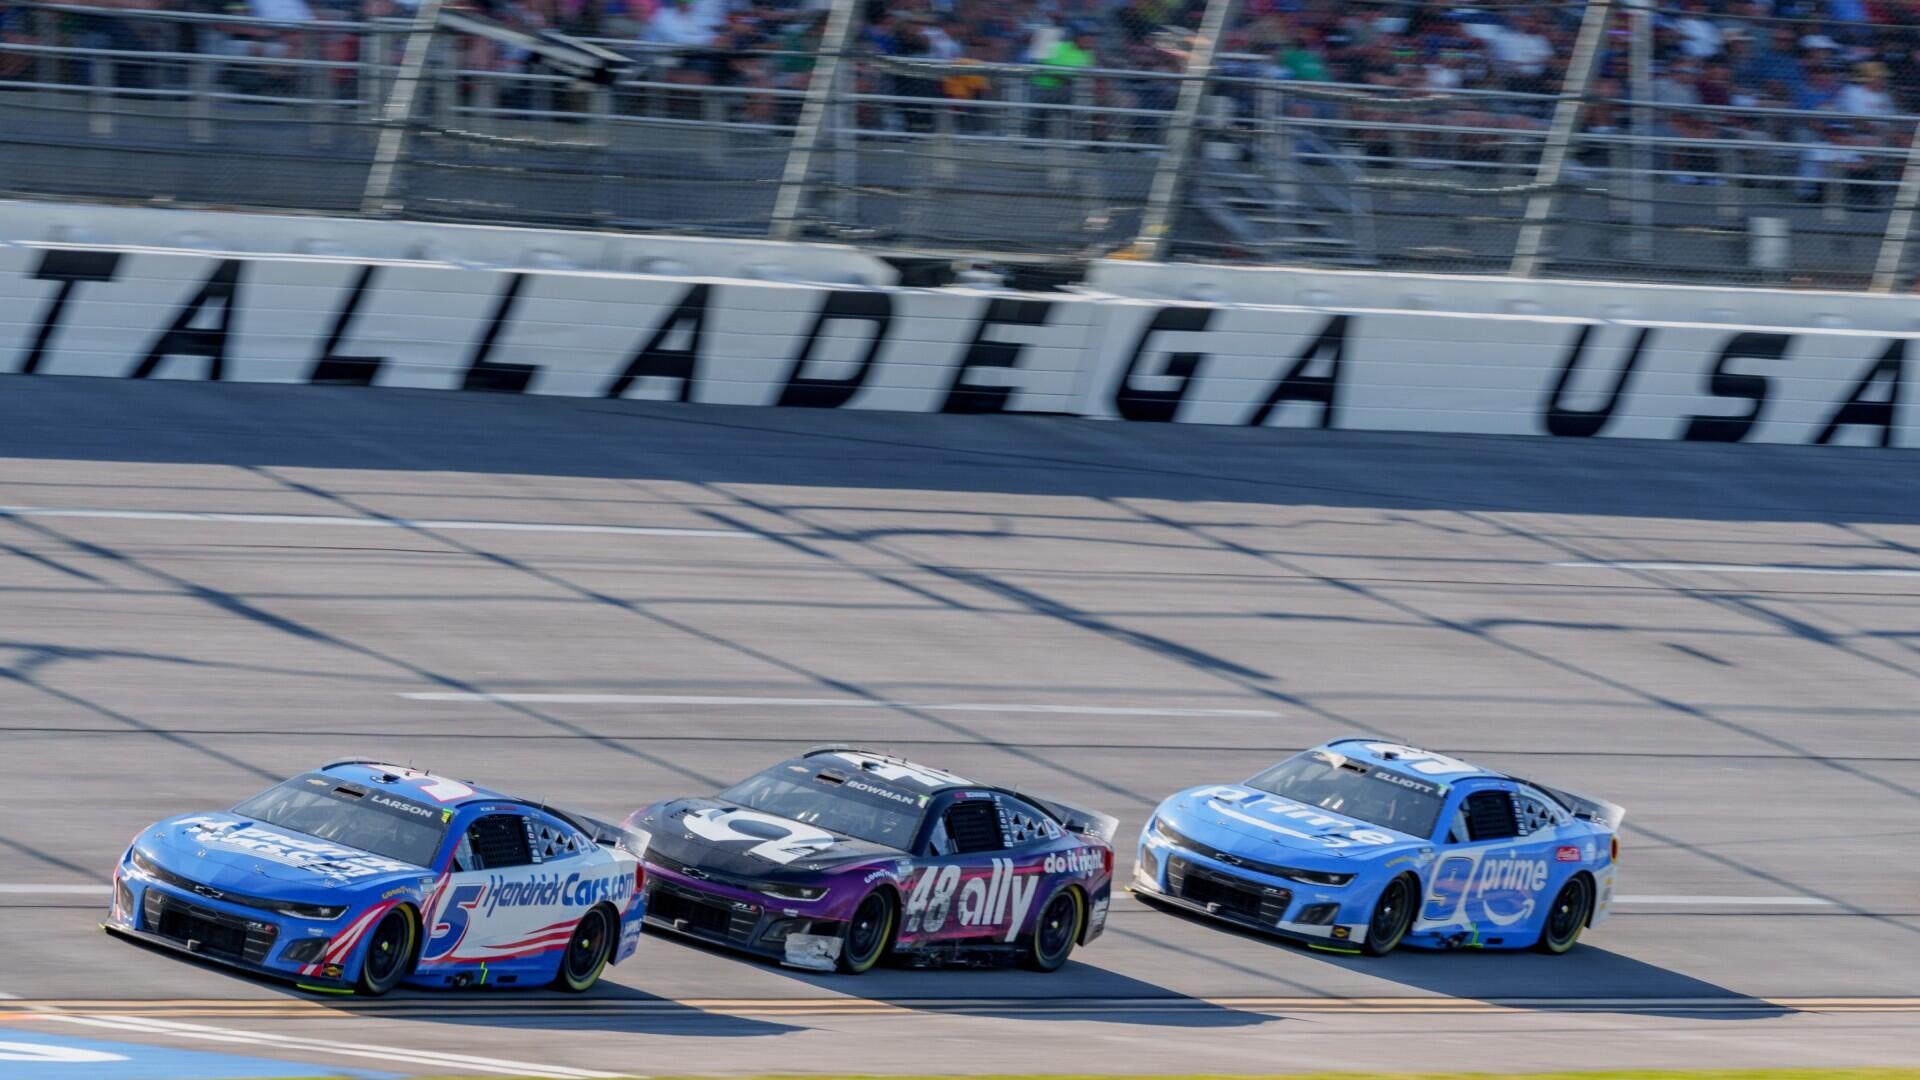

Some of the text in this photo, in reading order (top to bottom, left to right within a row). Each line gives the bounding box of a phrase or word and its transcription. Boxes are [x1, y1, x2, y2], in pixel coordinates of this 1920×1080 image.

[20, 249, 1908, 447] TALLADEGA USA
[371, 795, 433, 818] LARSON
[846, 780, 914, 804] BOWMAN
[1375, 772, 1434, 794] ELLIOTT
[1044, 853, 1066, 873] do
[1067, 849, 1079, 872] it
[1478, 850, 1548, 899] prime
[905, 865, 961, 932] 48
[958, 858, 1039, 942] ally
[1413, 850, 1486, 931] 9
[421, 883, 487, 963] 5
